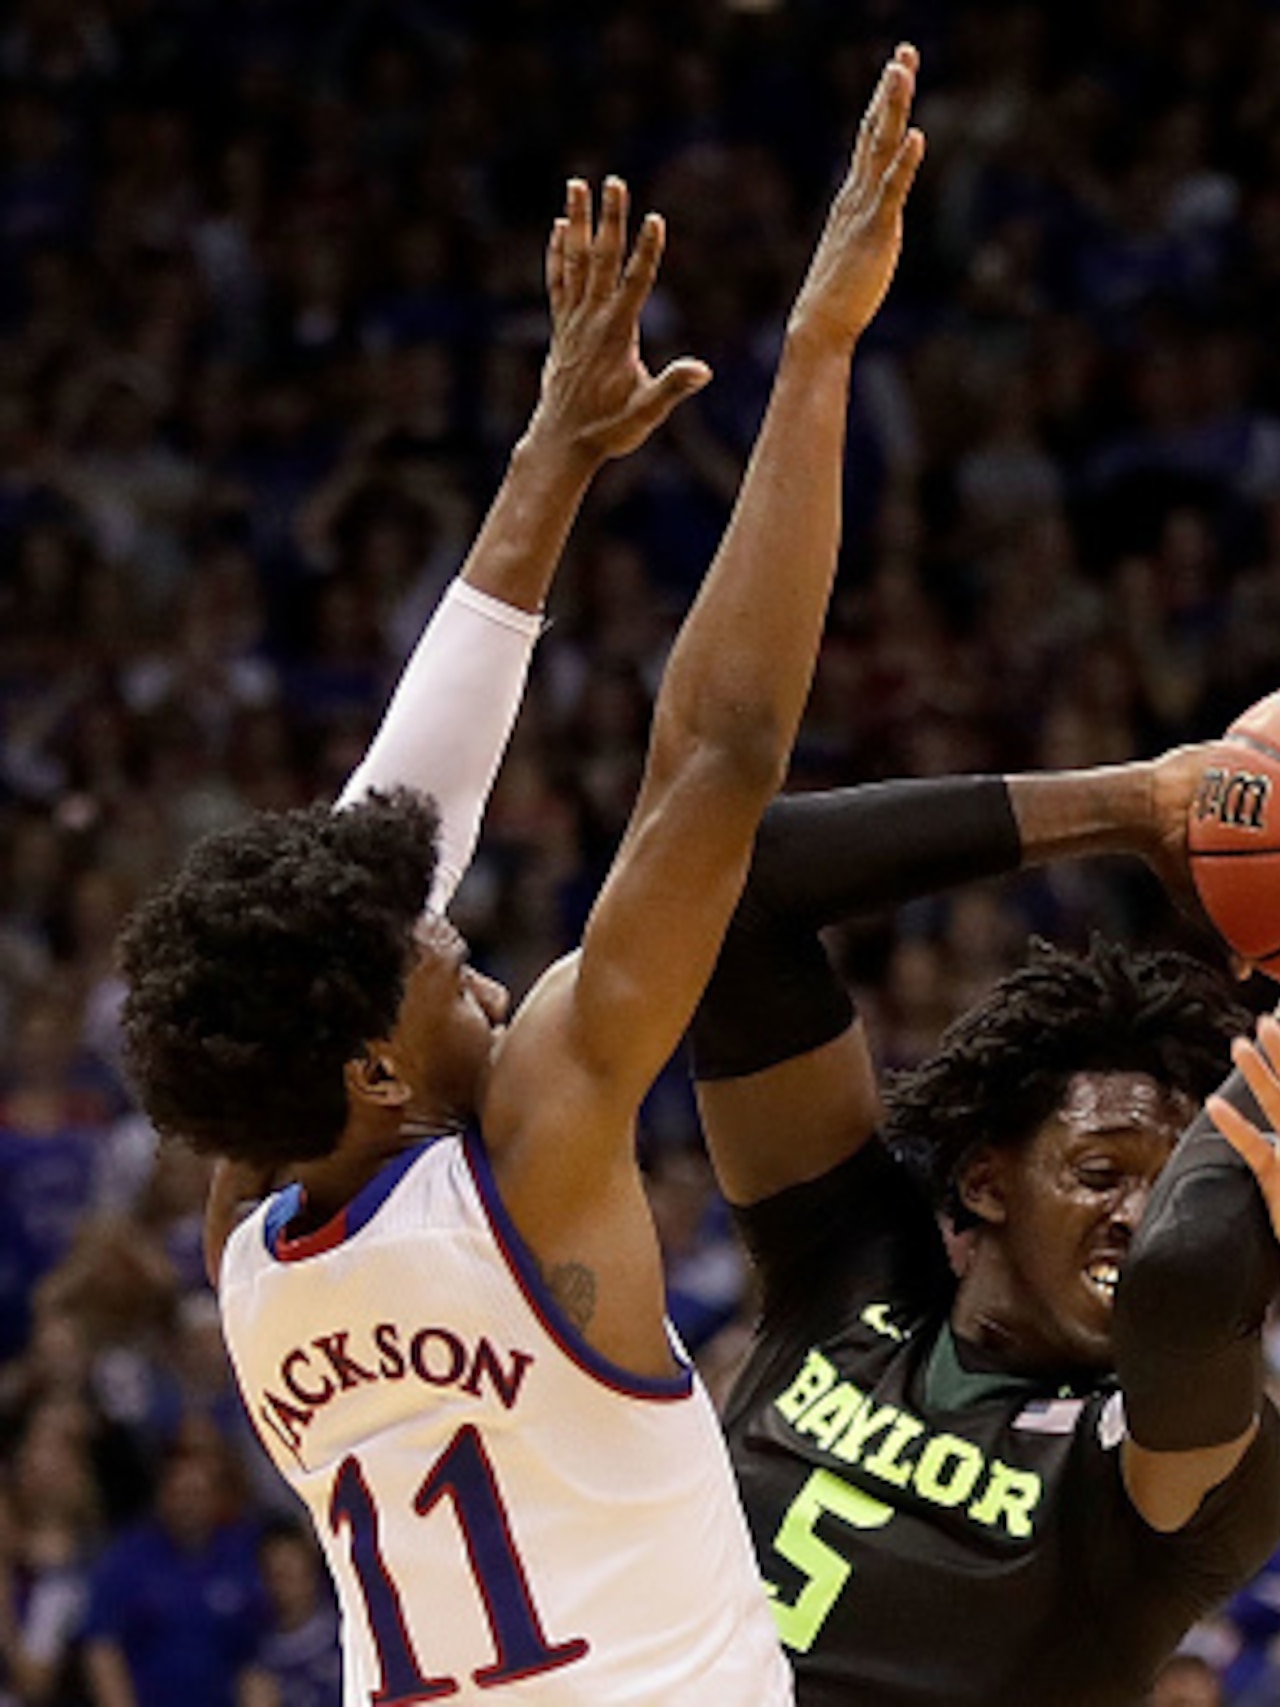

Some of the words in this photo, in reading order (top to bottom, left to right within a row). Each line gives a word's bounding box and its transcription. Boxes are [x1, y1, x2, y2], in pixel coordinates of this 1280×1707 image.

[774, 1349, 1042, 1538] BAYLOR
[329, 1423, 589, 1707] 11
[762, 1468, 894, 1653] 5
